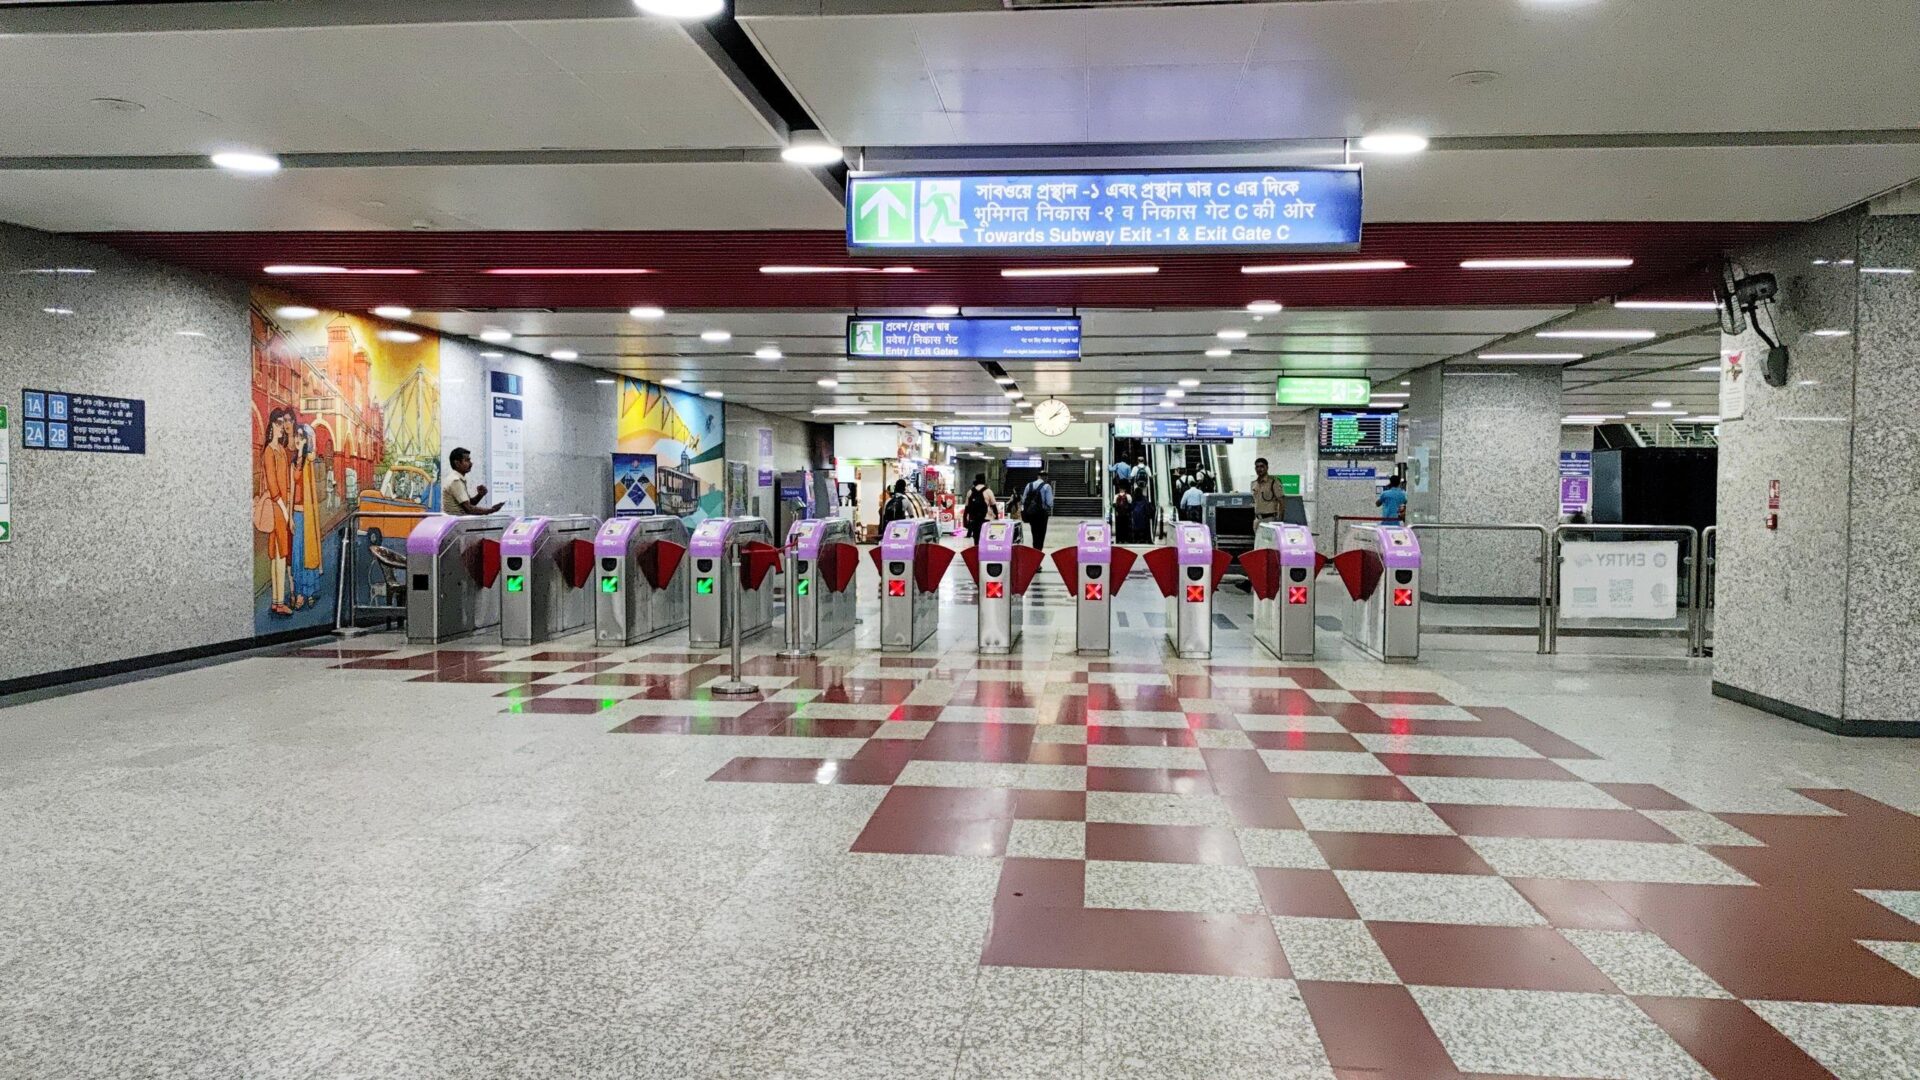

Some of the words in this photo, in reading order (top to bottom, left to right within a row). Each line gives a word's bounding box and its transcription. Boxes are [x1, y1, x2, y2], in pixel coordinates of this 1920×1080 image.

[975, 183, 1032, 200] সাবওয়ে
[1037, 184, 1078, 203] প্রস্থান
[1106, 183, 1138, 200] এবং
[1141, 182, 1182, 202] প্রস্থান
[1186, 180, 1212, 198] দ্বার
[1217, 183, 1230, 196] C
[1234, 181, 1258, 196] এর
[1262, 176, 1300, 197] দিকে
[974, 202, 1029, 227] भूमिगत
[1036, 202, 1091, 221] निकास
[1121, 206, 1134, 220] व
[1142, 200, 1198, 220] निकास
[1204, 200, 1231, 220] गेट
[1235, 206, 1248, 220] C
[1252, 198, 1276, 219] की
[1282, 198, 1317, 218] ओर
[974, 228, 1044, 243] Towards
[1050, 228, 1115, 246] Subway
[1120, 227, 1152, 242] Exit
[1156, 228, 1170, 241] -1
[1176, 227, 1190, 241] &
[1195, 226, 1228, 241] Exit
[1232, 226, 1272, 241] Gate
[1277, 226, 1290, 240] C
[912, 334, 941, 344] निकास
[944, 334, 958, 344] गेट
[914, 347, 932, 356] Exit
[933, 347, 959, 356] Gates
[28, 398, 42, 412] 1A
[52, 400, 64, 414] 1B
[27, 427, 43, 441] 2A
[51, 428, 65, 442] 2B
